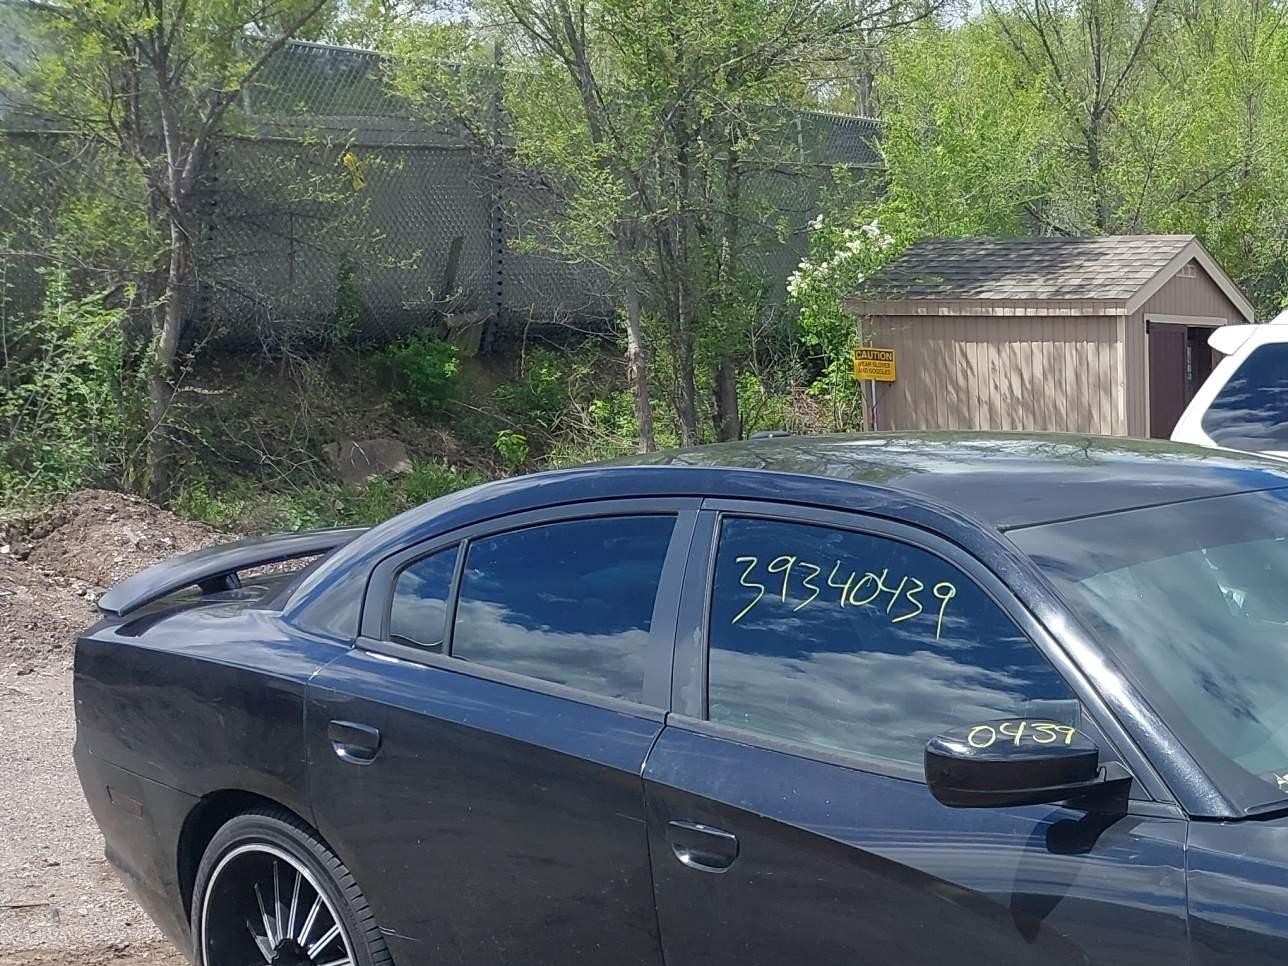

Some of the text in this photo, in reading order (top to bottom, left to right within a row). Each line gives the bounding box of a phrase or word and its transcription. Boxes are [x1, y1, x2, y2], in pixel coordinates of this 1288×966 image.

[855, 350, 892, 361] CAUTION
[731, 555, 957, 641] 39340439
[967, 721, 1076, 748] 0439
